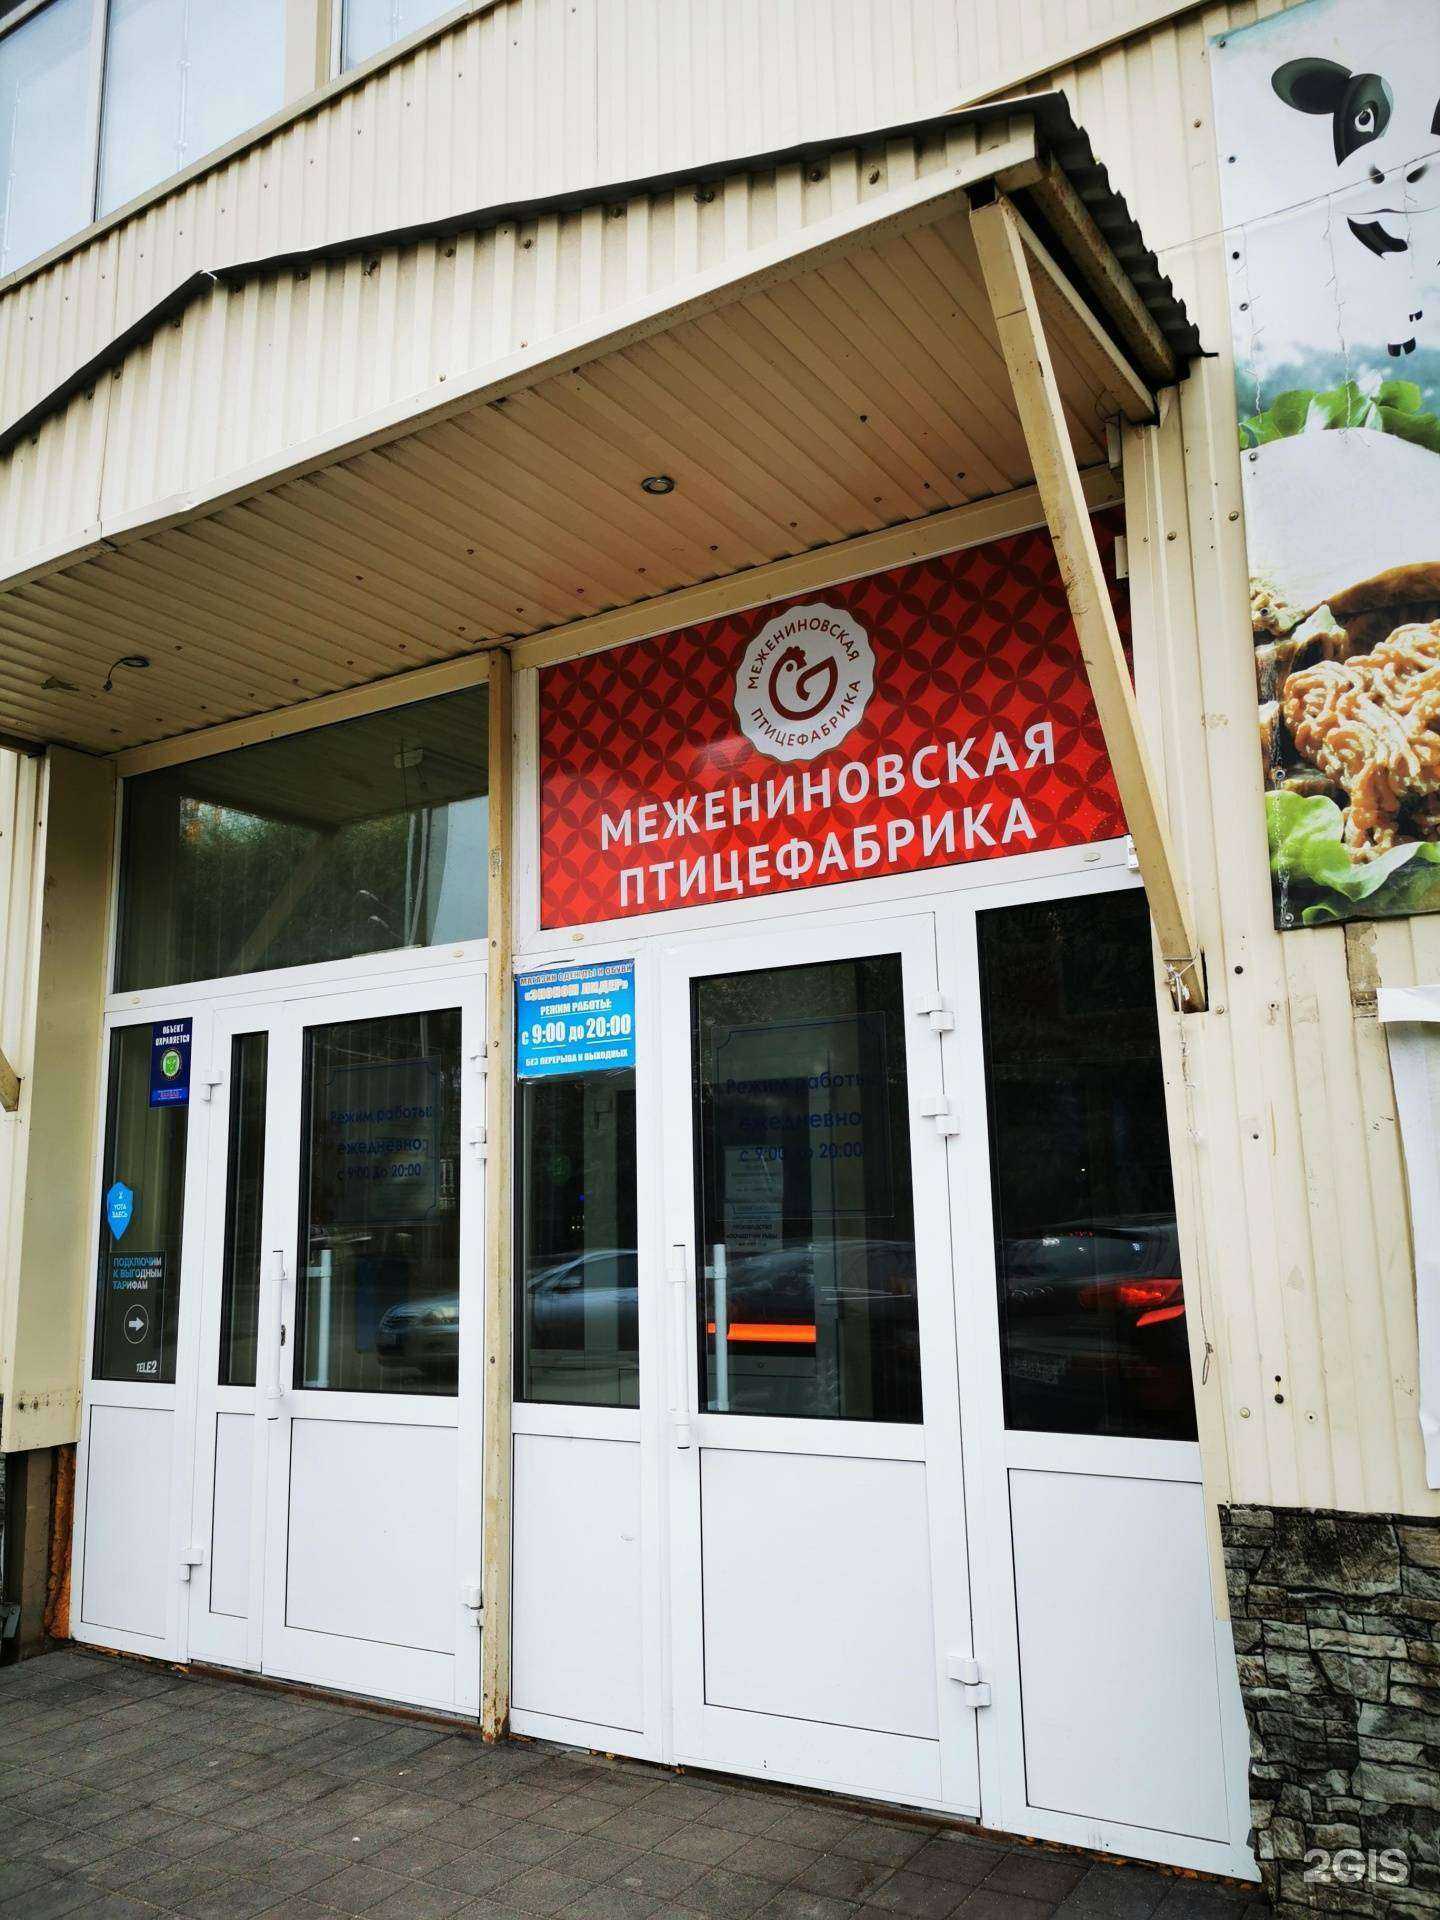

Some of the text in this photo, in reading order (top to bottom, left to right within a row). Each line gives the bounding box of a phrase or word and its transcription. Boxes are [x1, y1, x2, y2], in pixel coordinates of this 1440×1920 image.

[748, 618, 860, 689] МЕЖЕНИНОВСКАЯ
[751, 680, 861, 747] ПТИЦЕФАБРИКА
[601, 721, 1056, 851] МЕЖЕНИНОВСКАЯ
[620, 797, 1038, 908] ПТИЦЕФАБРИКА
[540, 1004, 571, 1016] РЕЖИМ
[531, 1021, 566, 1044] 9:00
[586, 1014, 631, 1038] 20:00
[113, 1256, 162, 1268] ПОДКЛЮЧИМ
[112, 1268, 162, 1280] К ВЫГОДНЫМ
[112, 1279, 148, 1290] ТАРИФАМ
[136, 1360, 158, 1374] TELE2
